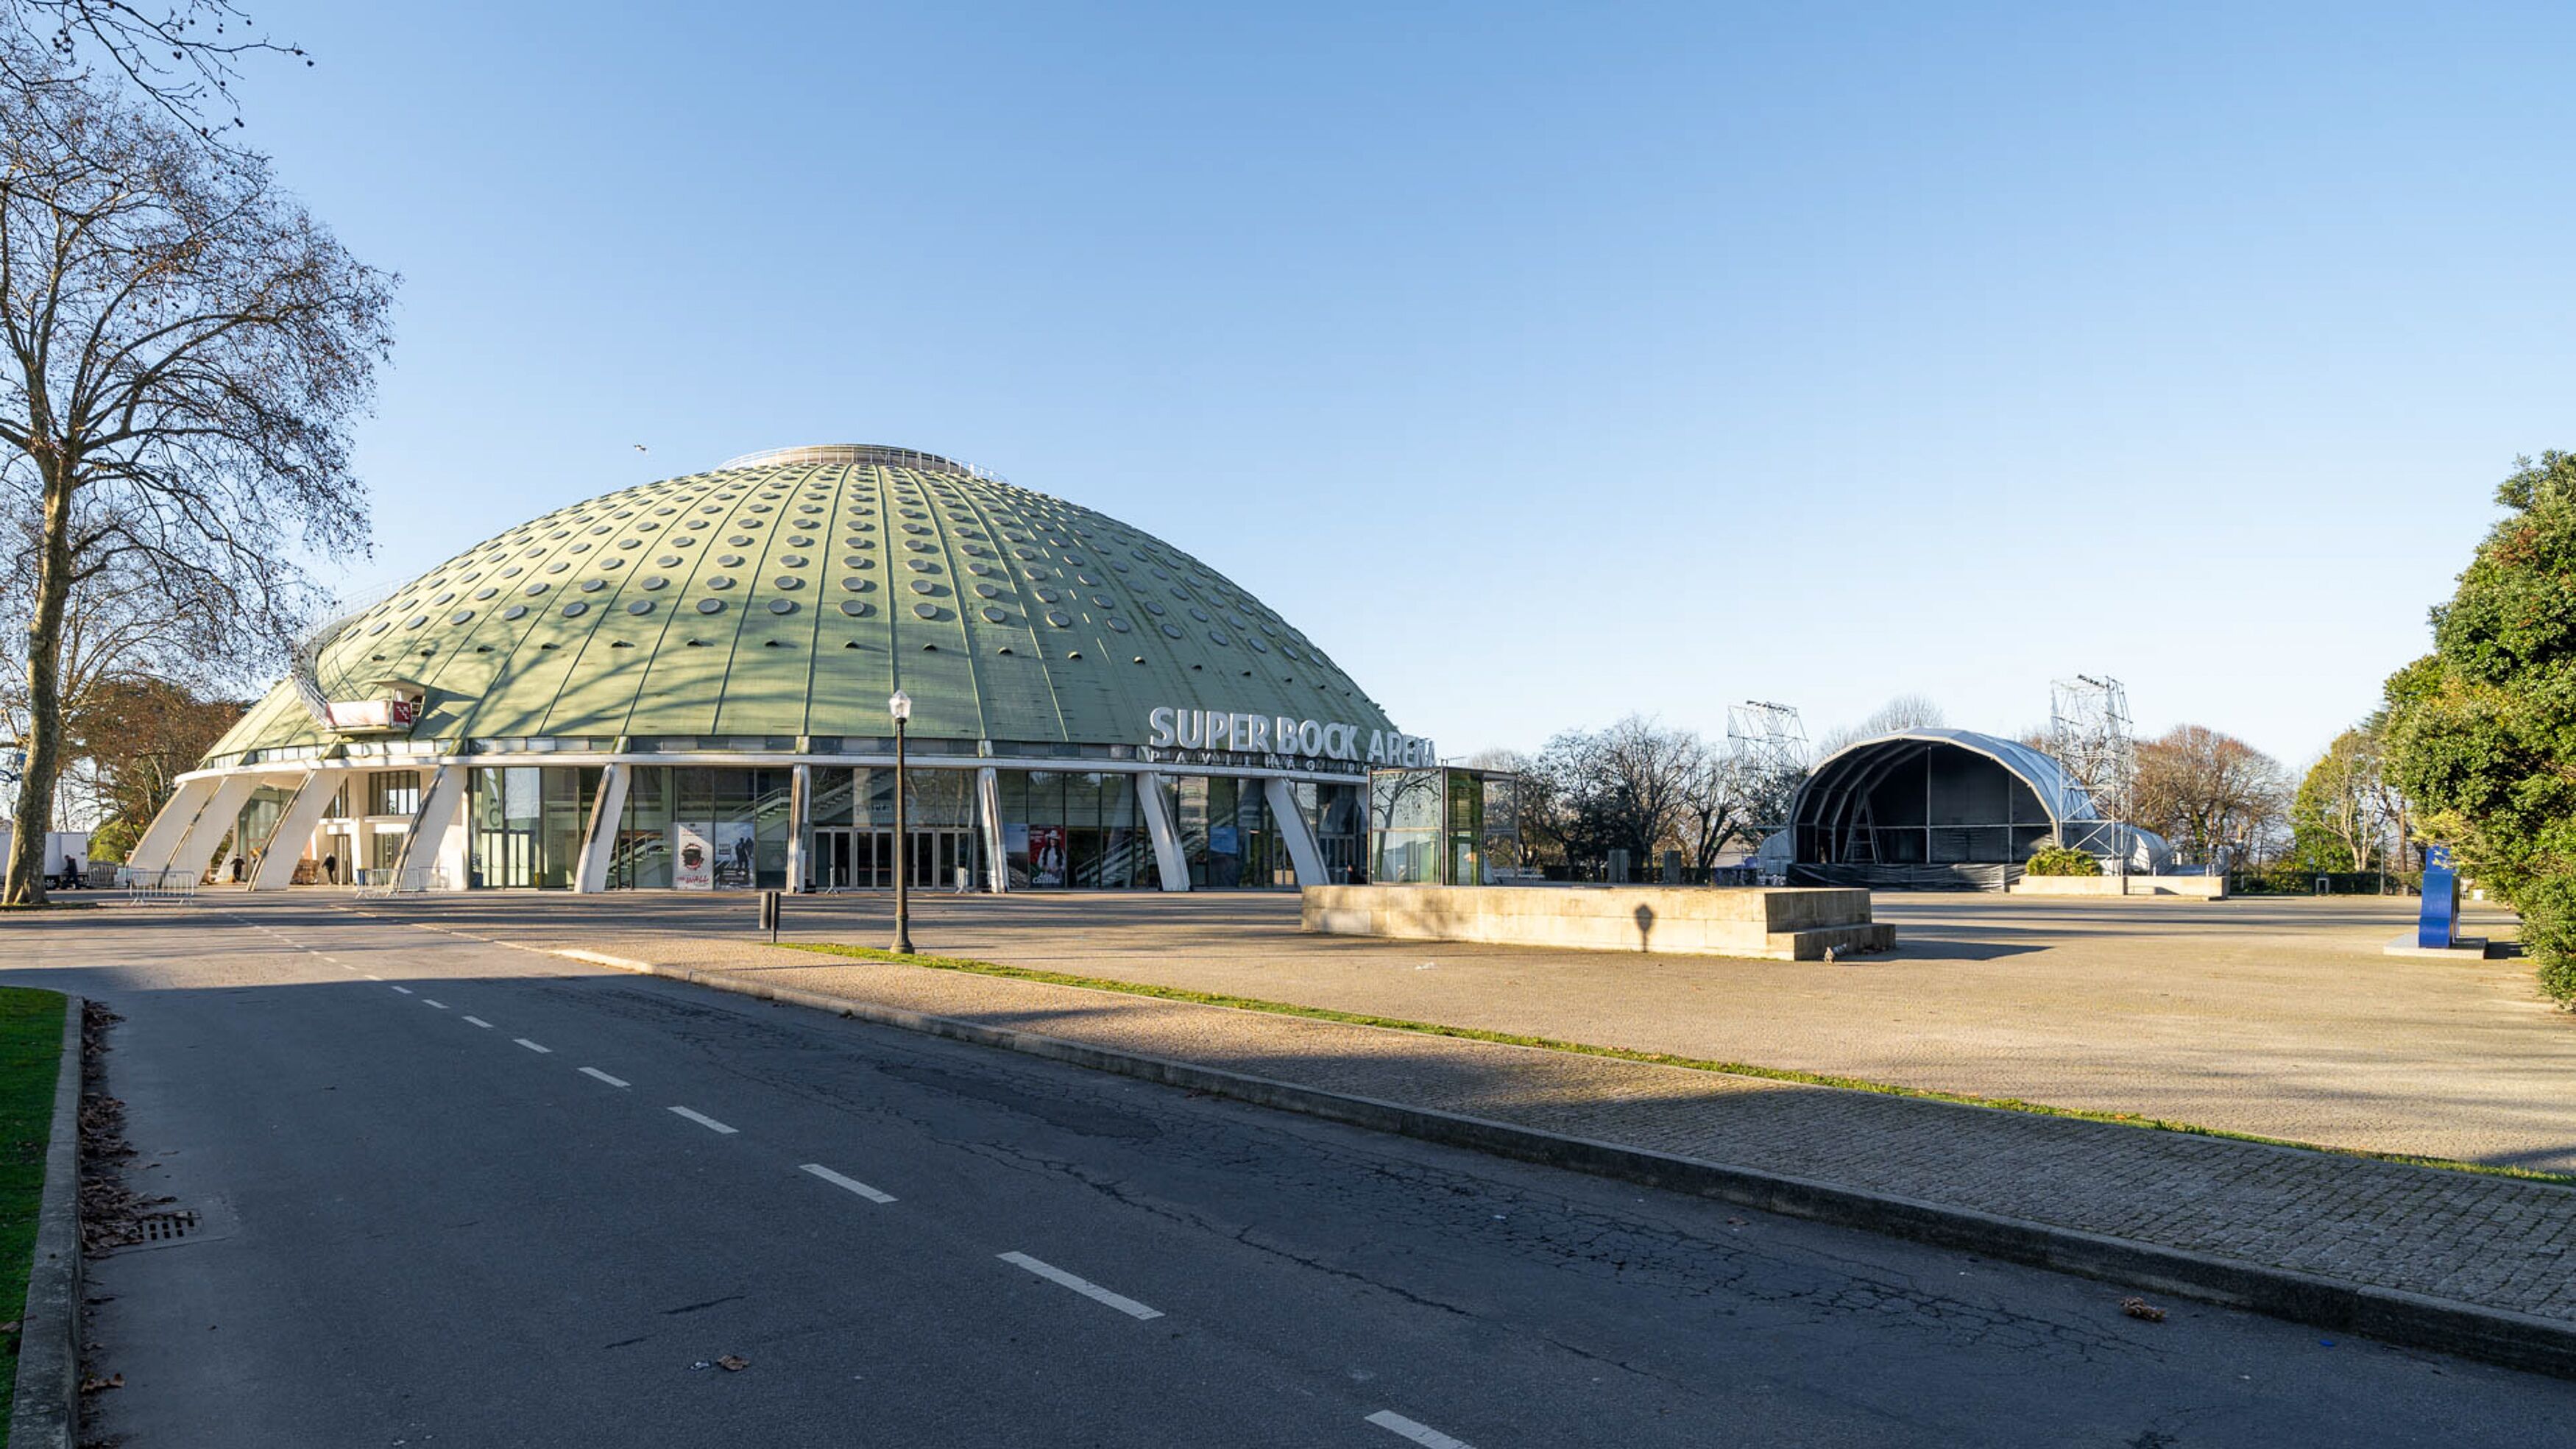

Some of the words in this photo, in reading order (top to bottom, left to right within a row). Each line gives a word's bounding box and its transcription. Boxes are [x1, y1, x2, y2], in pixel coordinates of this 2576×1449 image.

[1150, 707, 1270, 753] SUPER
[1277, 717, 1359, 761] BOCK
[1367, 729, 1436, 767] ARENA
